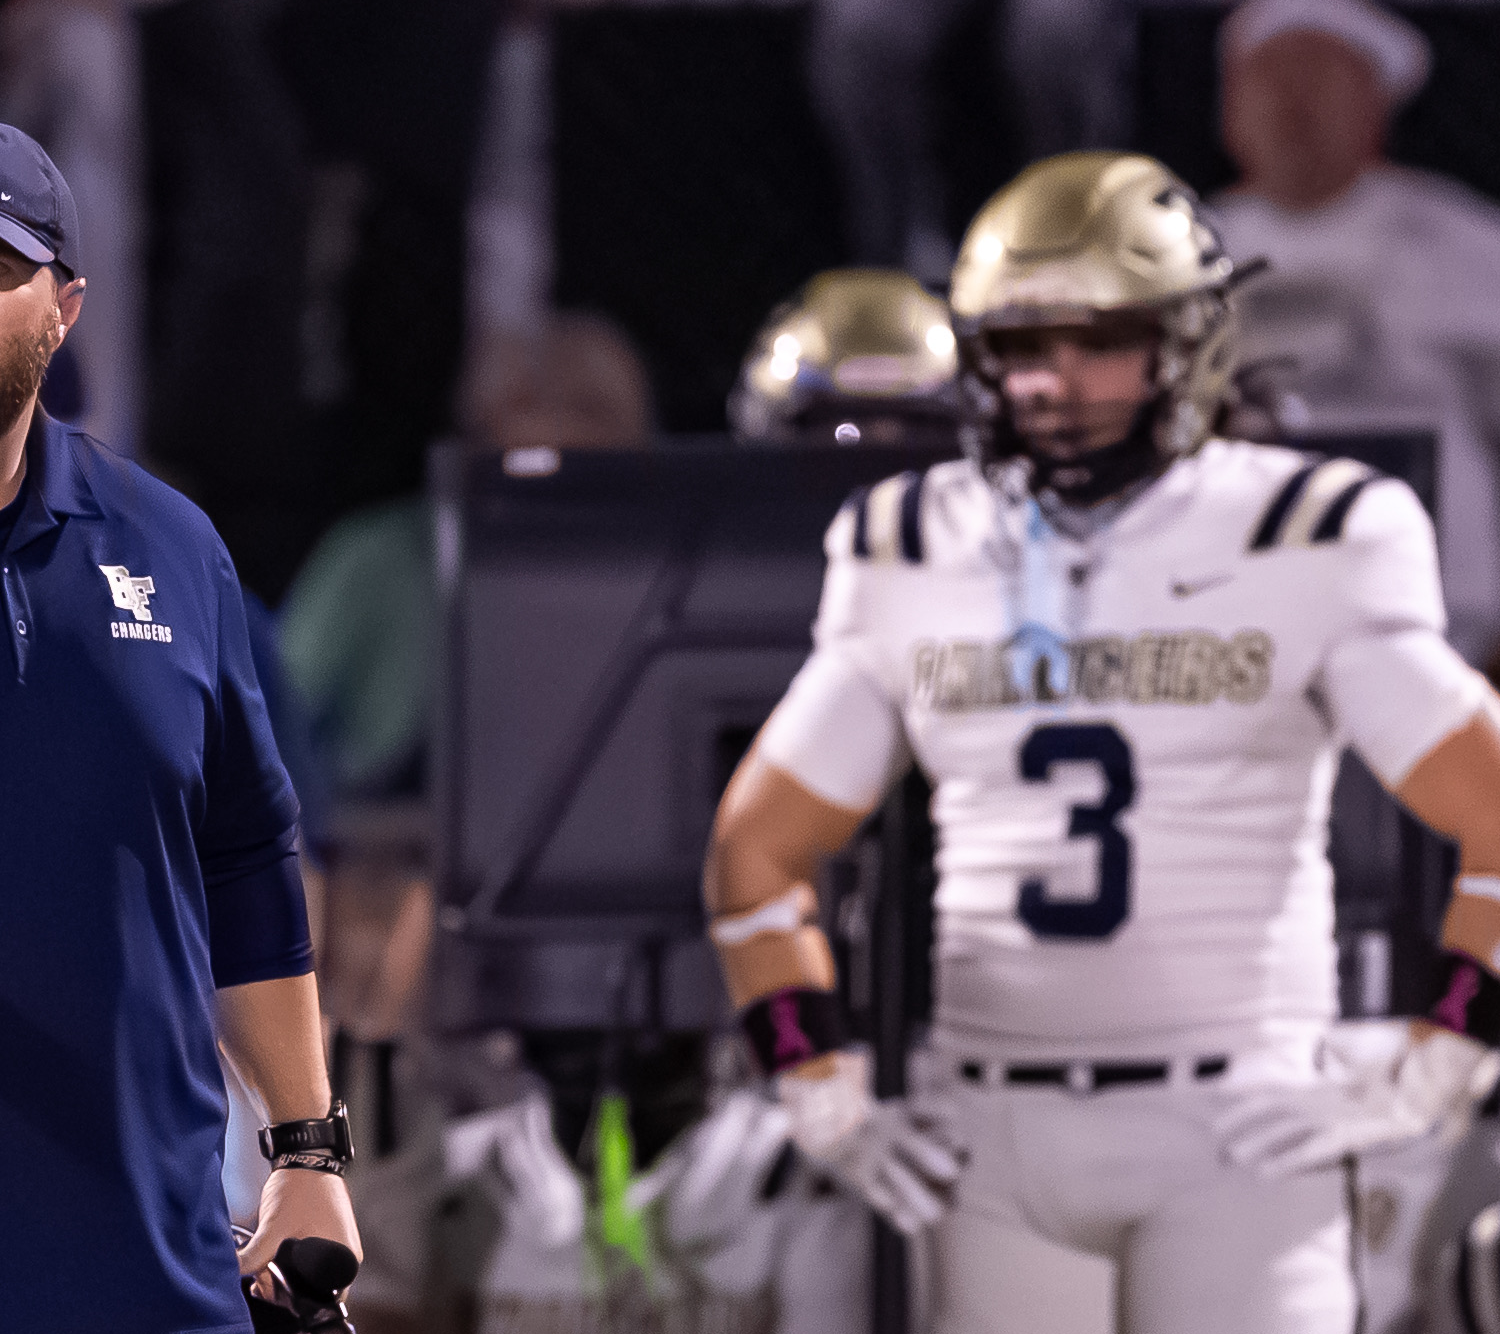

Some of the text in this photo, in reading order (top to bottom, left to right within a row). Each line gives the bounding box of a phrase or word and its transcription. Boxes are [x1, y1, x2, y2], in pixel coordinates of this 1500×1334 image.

[98, 564, 156, 622] BF
[110, 621, 173, 643] CHARGERS
[1018, 720, 1137, 941] 3
